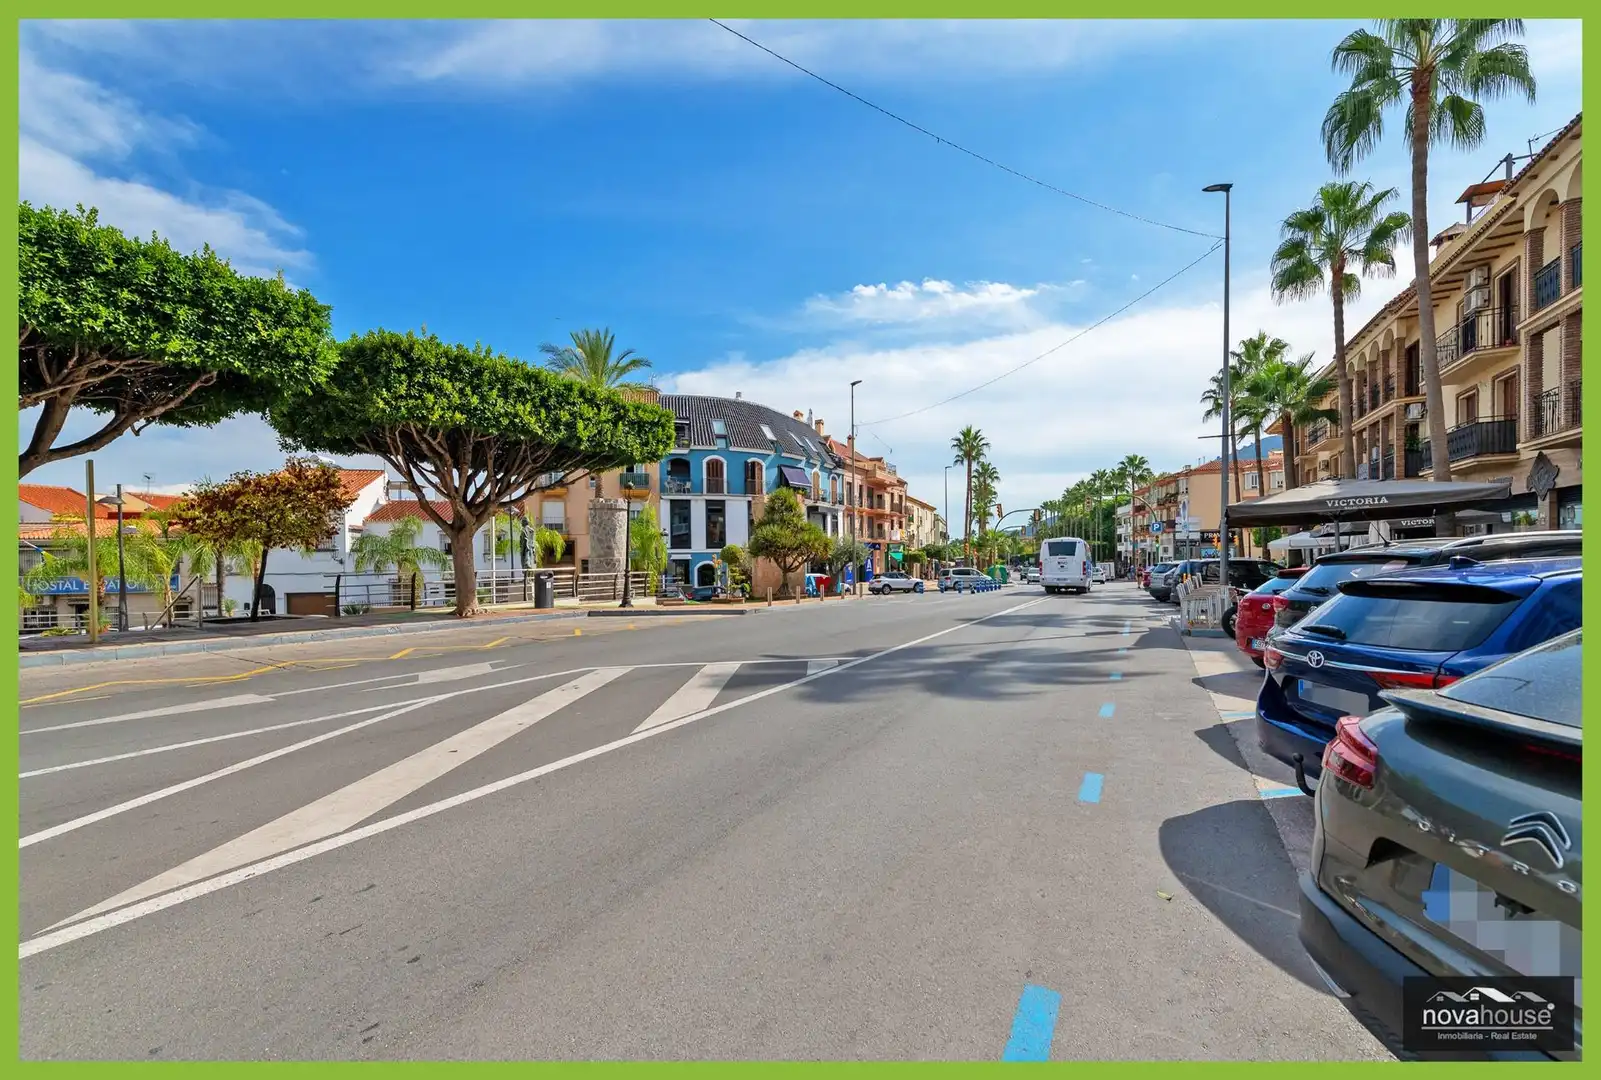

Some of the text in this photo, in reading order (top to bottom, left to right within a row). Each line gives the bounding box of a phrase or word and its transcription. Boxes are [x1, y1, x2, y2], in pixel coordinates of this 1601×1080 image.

[1326, 496, 1389, 508] VICTORIA
[1153, 523, 1160, 531] P
[27, 580, 79, 591] HOSTAL
